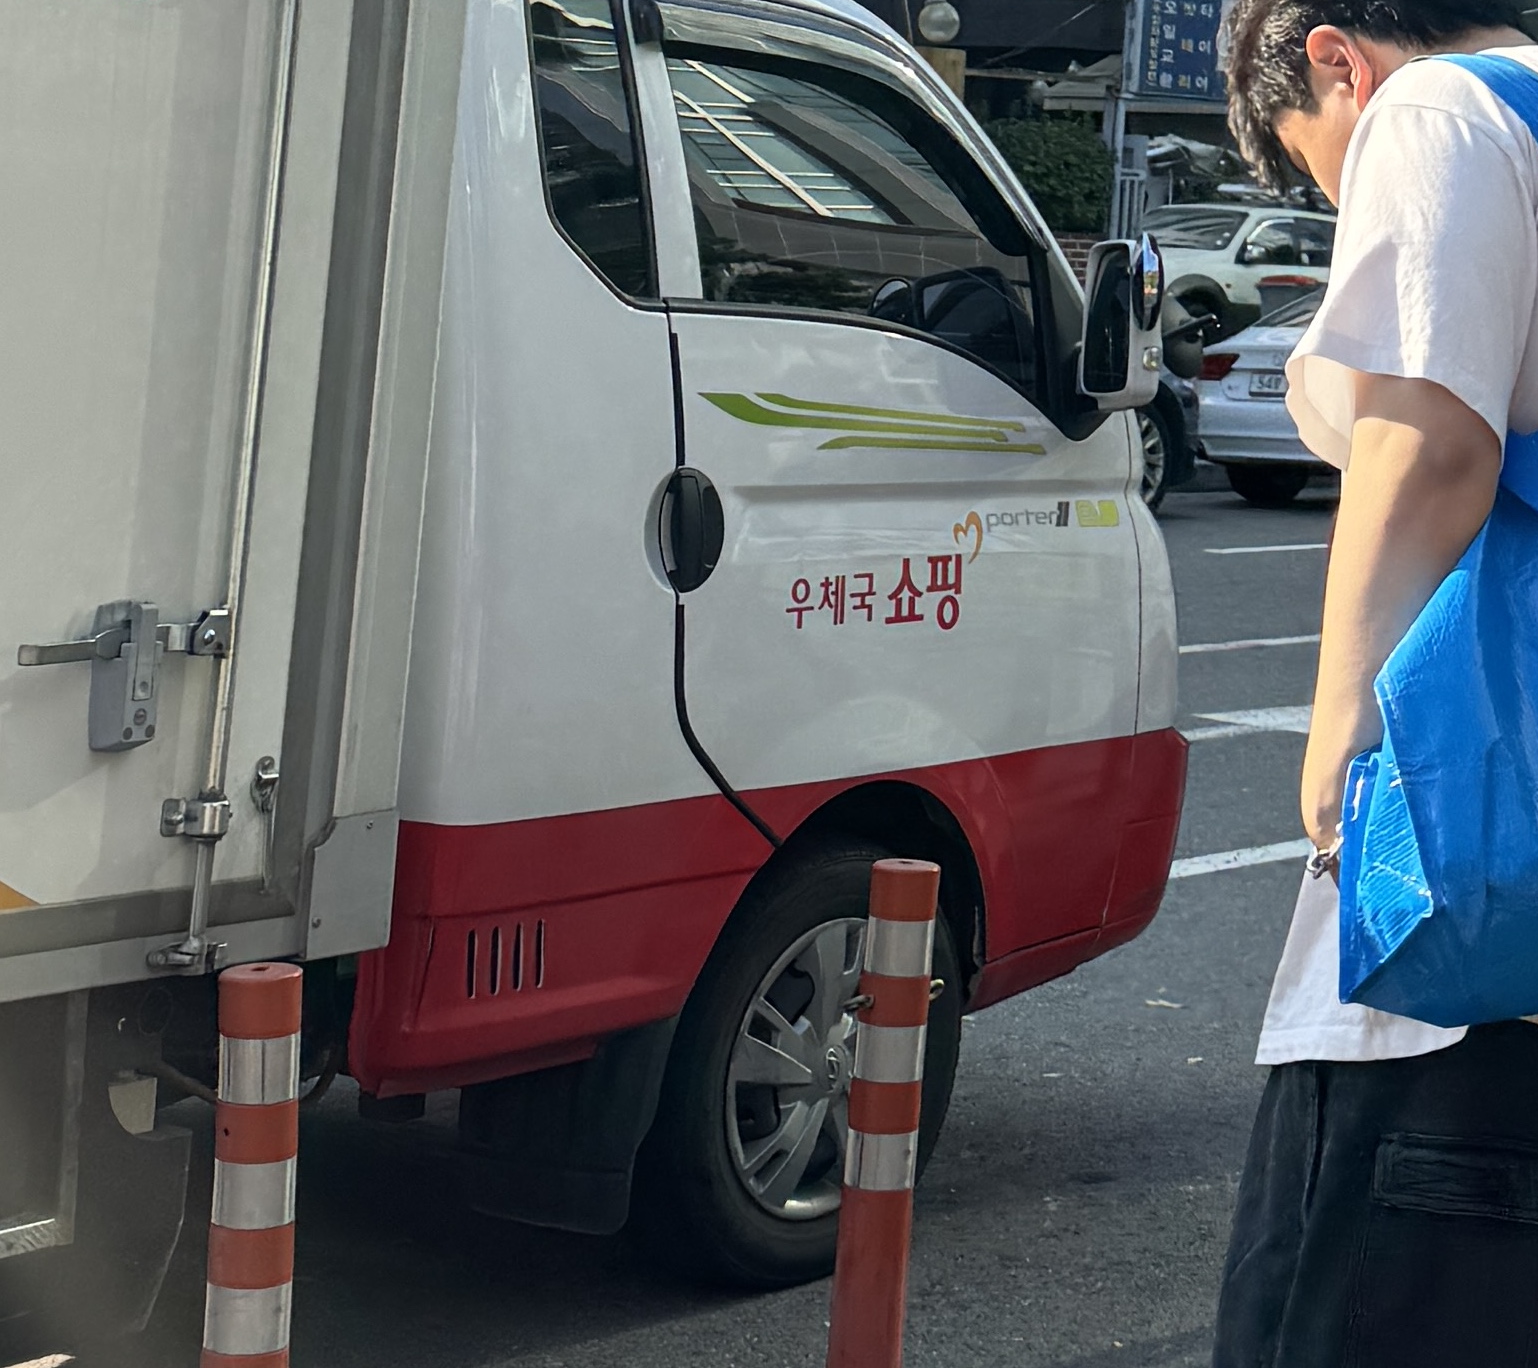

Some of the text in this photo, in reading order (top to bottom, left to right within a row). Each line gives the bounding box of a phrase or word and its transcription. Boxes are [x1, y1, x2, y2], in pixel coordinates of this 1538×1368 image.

[986, 509, 1058, 533] porter
[785, 553, 963, 631] 우체국 쇼핑
